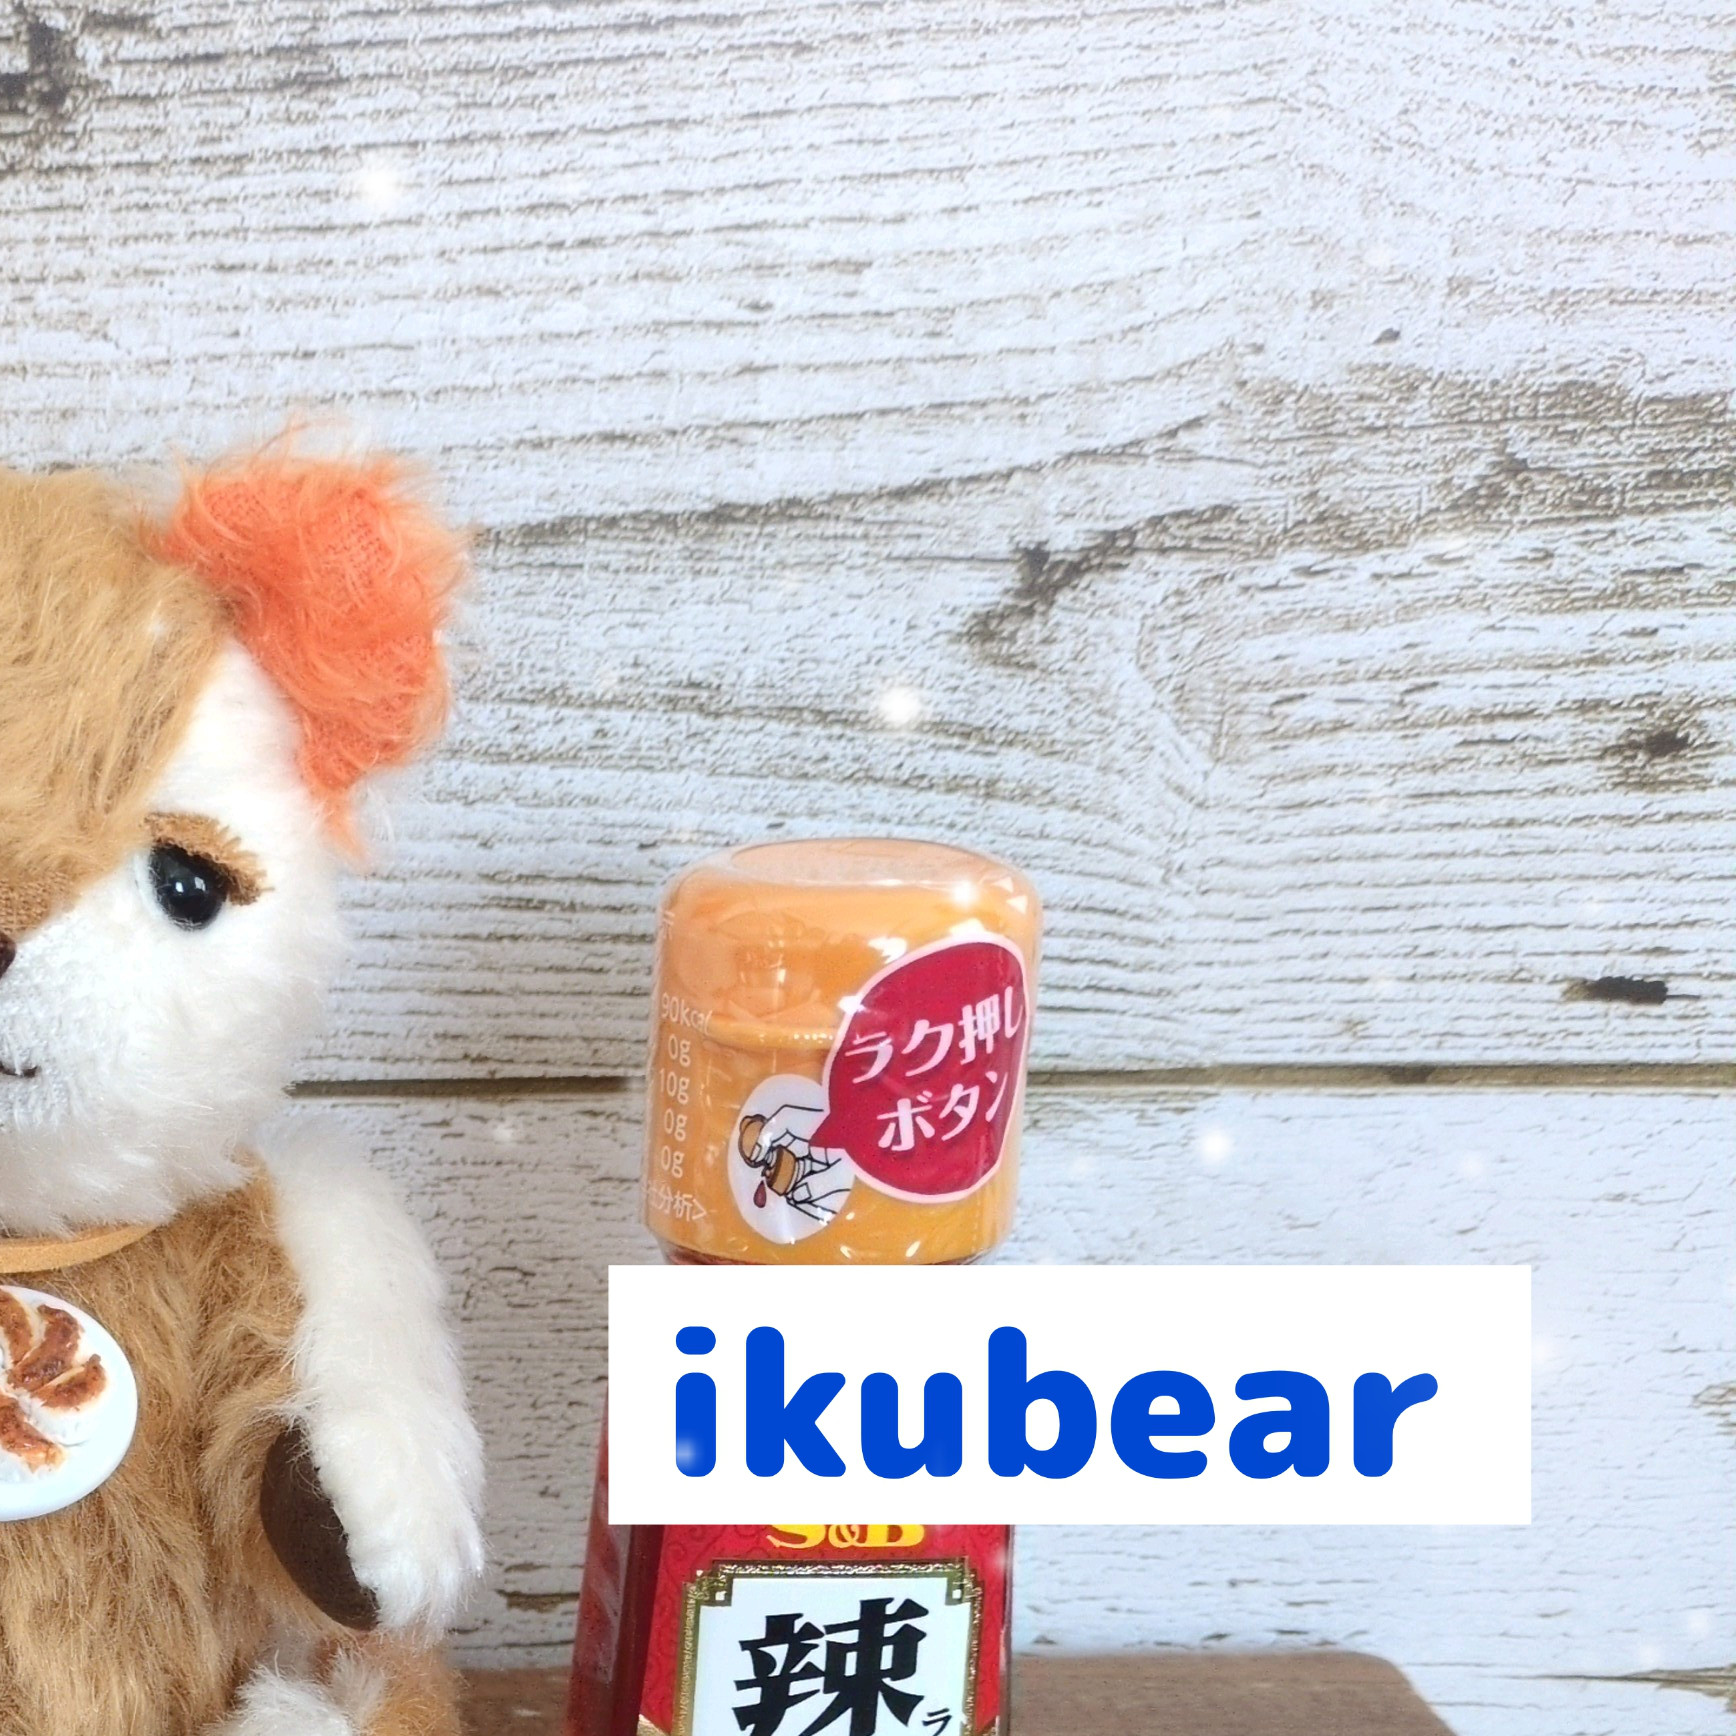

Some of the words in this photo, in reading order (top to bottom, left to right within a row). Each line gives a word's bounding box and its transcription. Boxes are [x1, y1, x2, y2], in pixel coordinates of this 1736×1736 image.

[844, 985, 1024, 1084] ラク押し
[876, 1070, 1008, 1152] ボタン
